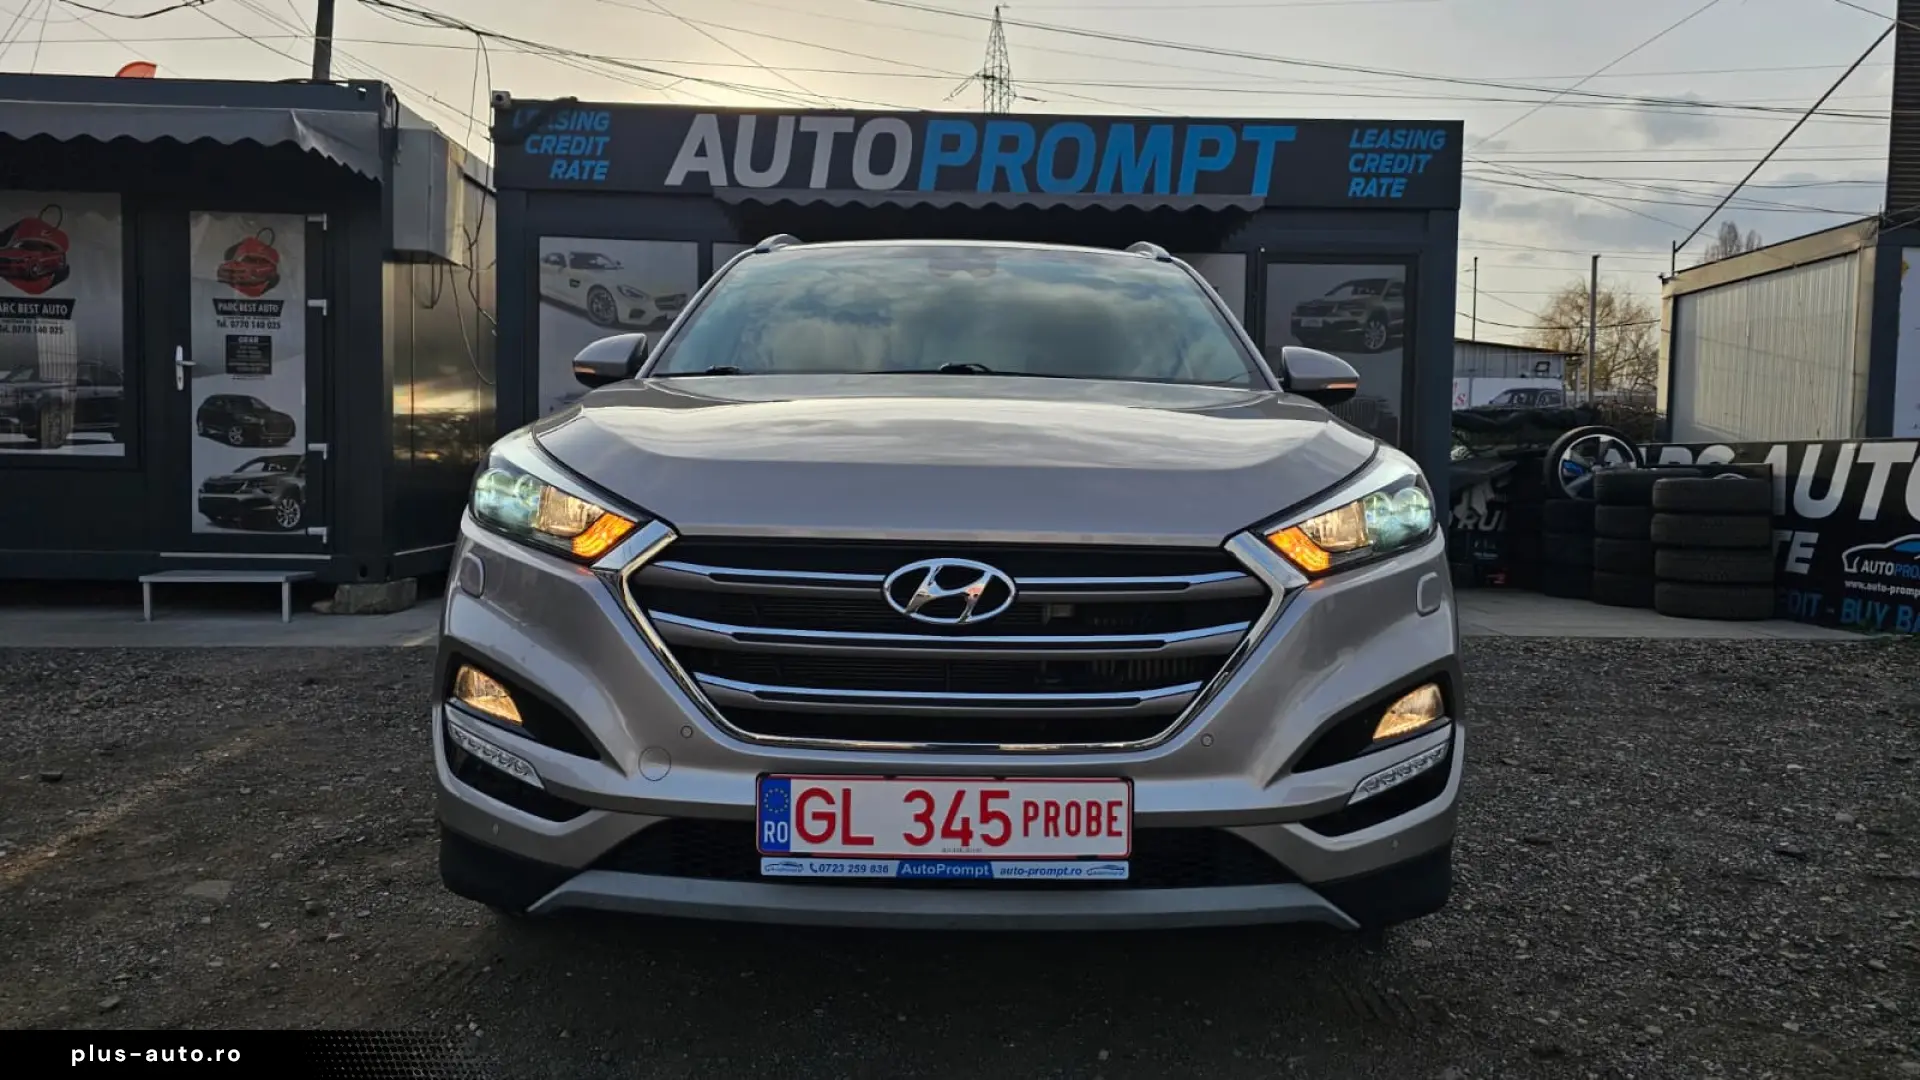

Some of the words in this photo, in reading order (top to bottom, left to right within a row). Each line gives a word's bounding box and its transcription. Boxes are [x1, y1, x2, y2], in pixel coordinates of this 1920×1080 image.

[513, 108, 611, 131] LSING
[524, 133, 610, 156] CREDIT
[1348, 128, 1446, 149] LEASING
[664, 113, 1297, 197] AUTOPROMPT
[1348, 152, 1432, 174] CREDIT
[549, 158, 610, 180] RATE
[1347, 177, 1407, 198] RATE
[0, 302, 17, 313] ARC
[18, 303, 40, 314] BEST
[41, 304, 68, 316] AUTO
[218, 302, 239, 312] PARC
[240, 302, 257, 312] BEST
[258, 303, 280, 313] AUTO
[1764, 442, 1920, 521] AUT
[1860, 559, 1920, 579] AUTOPRO
[1844, 580, 1920, 599] www.auto-promp
[1840, 597, 1890, 629] BUY
[763, 820, 789, 844] RO
[794, 787, 875, 846] GL
[902, 789, 1013, 847] 345
[1022, 800, 1123, 838] PROBE
[819, 863, 845, 873] 0723
[847, 864, 866, 873] 259
[901, 863, 990, 877] AutoPrompt
[999, 866, 1082, 877] auto-prompt.ro
